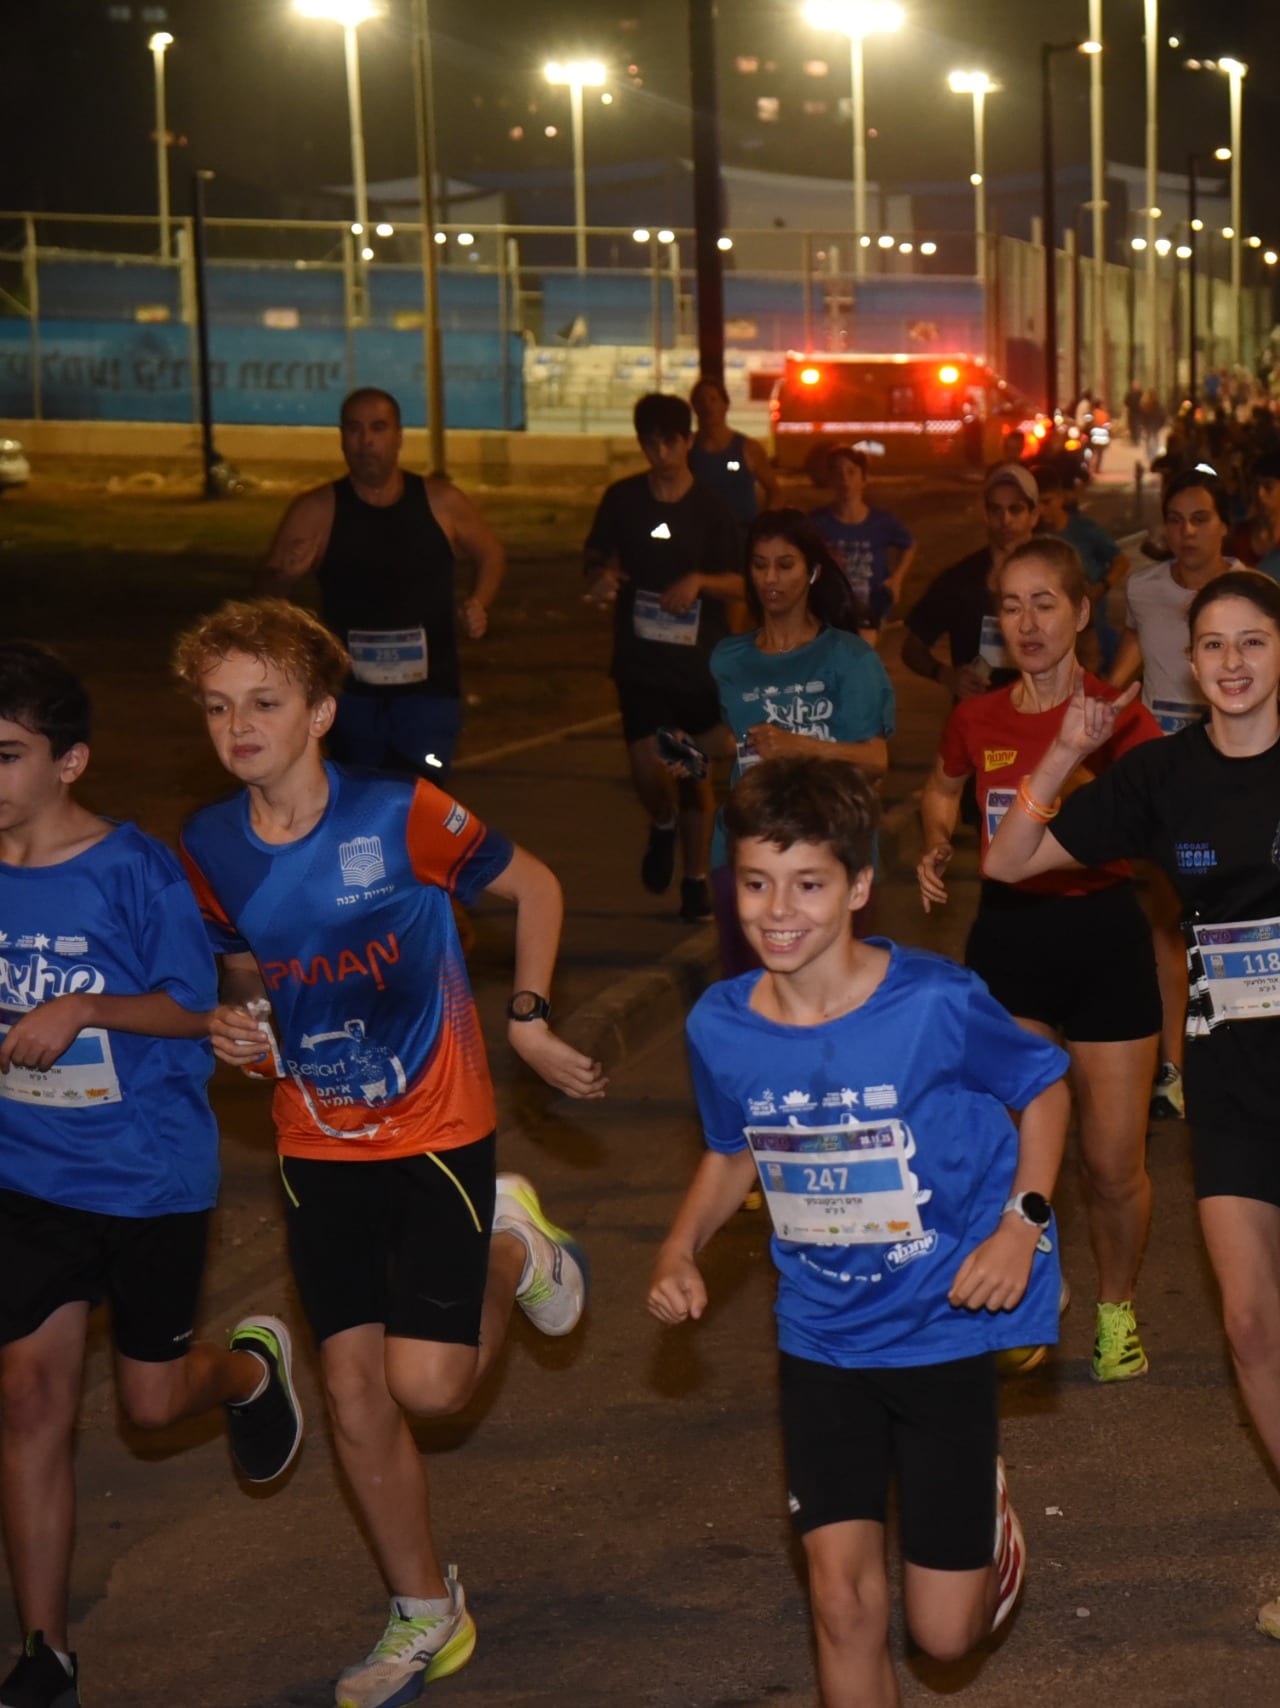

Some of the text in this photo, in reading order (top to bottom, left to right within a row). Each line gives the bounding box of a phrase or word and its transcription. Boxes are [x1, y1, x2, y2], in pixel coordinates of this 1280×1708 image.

[336, 884, 395, 907] עיריית יבנה
[804, 1167, 848, 1191] 247
